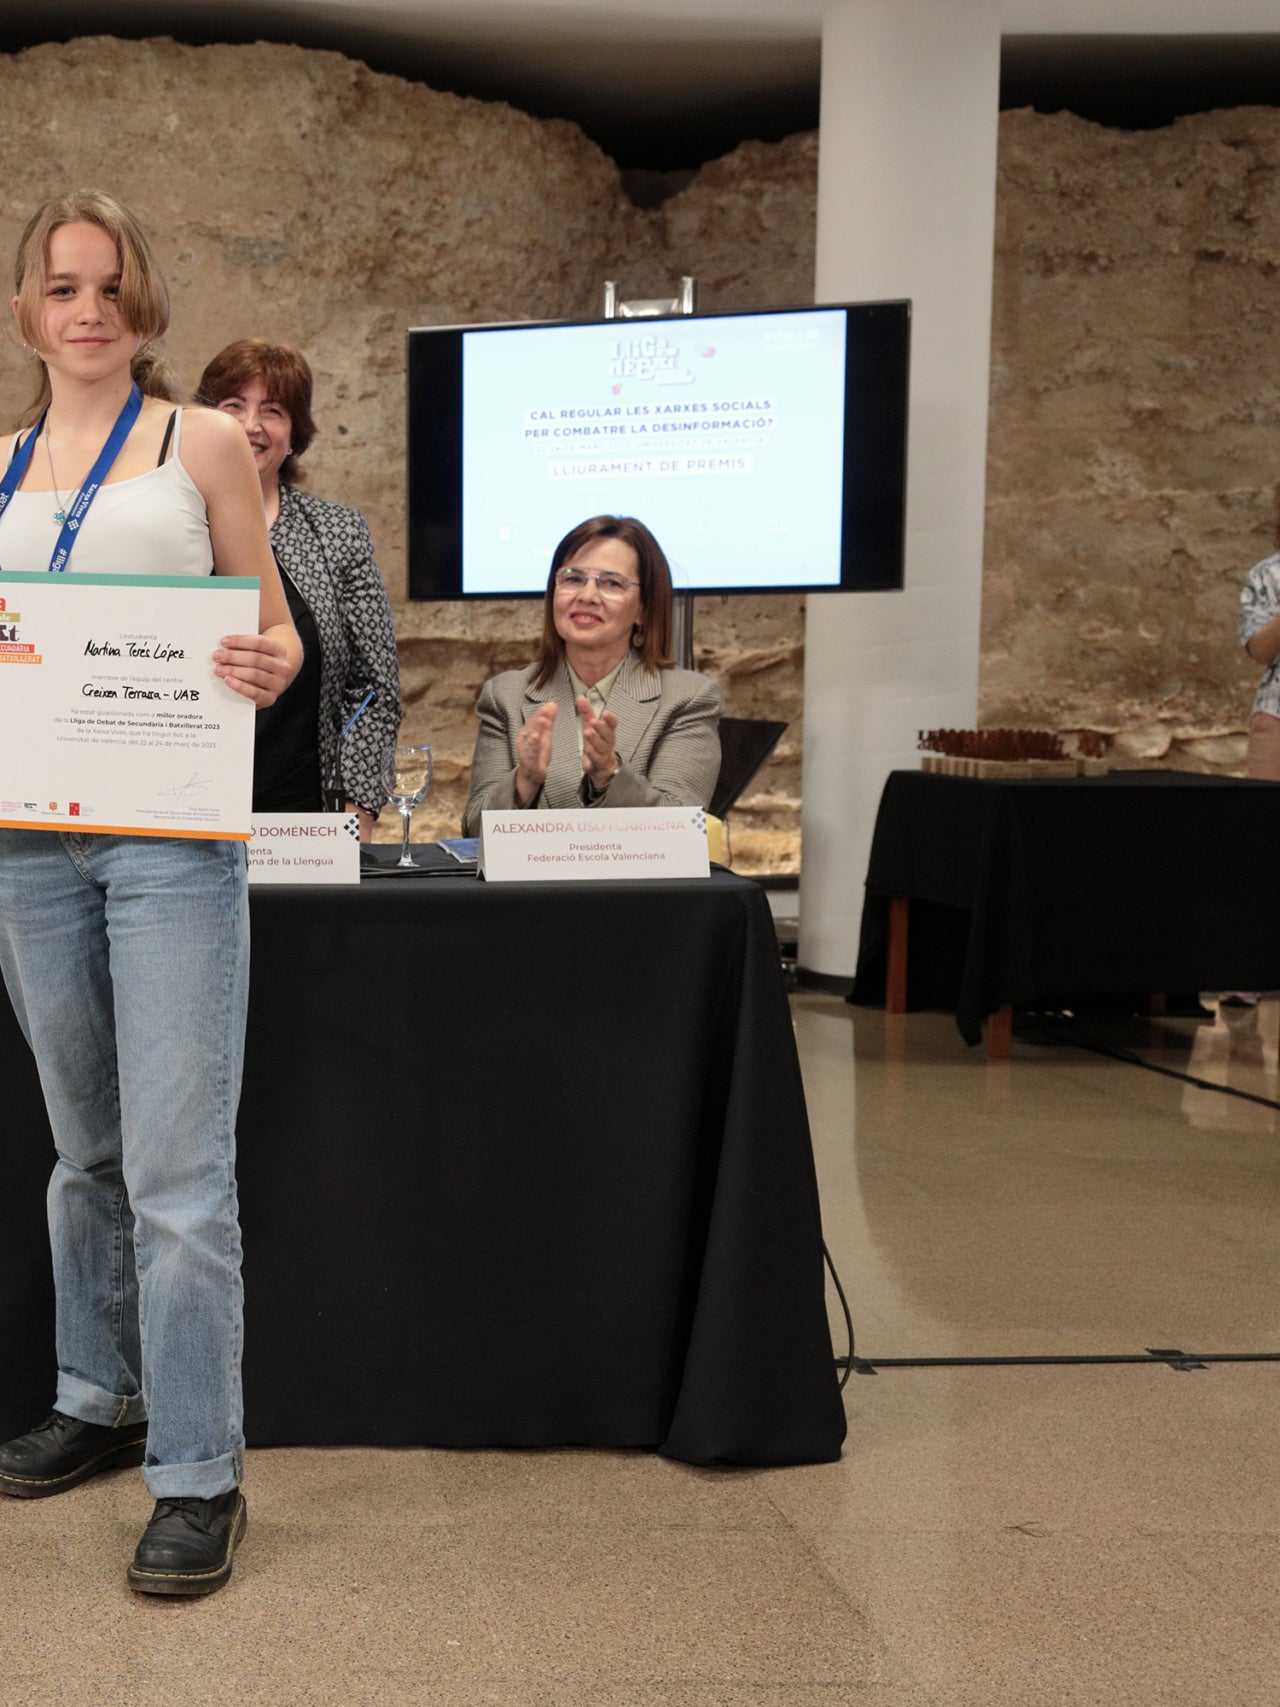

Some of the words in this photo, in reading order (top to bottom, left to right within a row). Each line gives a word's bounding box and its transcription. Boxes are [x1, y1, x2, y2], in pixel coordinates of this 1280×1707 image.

[530, 411, 556, 420] CAL
[560, 407, 621, 418] REGULAR
[626, 406, 650, 415] LES
[655, 403, 708, 414] XARXES
[713, 400, 771, 411] SOCIALS
[525, 429, 549, 438] PER
[553, 425, 626, 437] COMBATRE
[631, 424, 648, 433] LA
[554, 462, 652, 476] LLIURAMENT
[660, 461, 679, 471] DE
[687, 458, 745, 470] PREMIS
[0, 613, 11, 621] de
[84, 639, 121, 656] Martina
[153, 643, 185, 662] López
[173, 689, 200, 701] UAB
[492, 822, 574, 834] ALEXANDRA
[569, 843, 622, 851] Presidenta
[267, 857, 279, 866] de
[282, 857, 291, 866] la
[293, 857, 334, 867] Llengua
[527, 853, 575, 862] Federació
[578, 853, 609, 861] Escola
[611, 851, 665, 860] Valenciana
